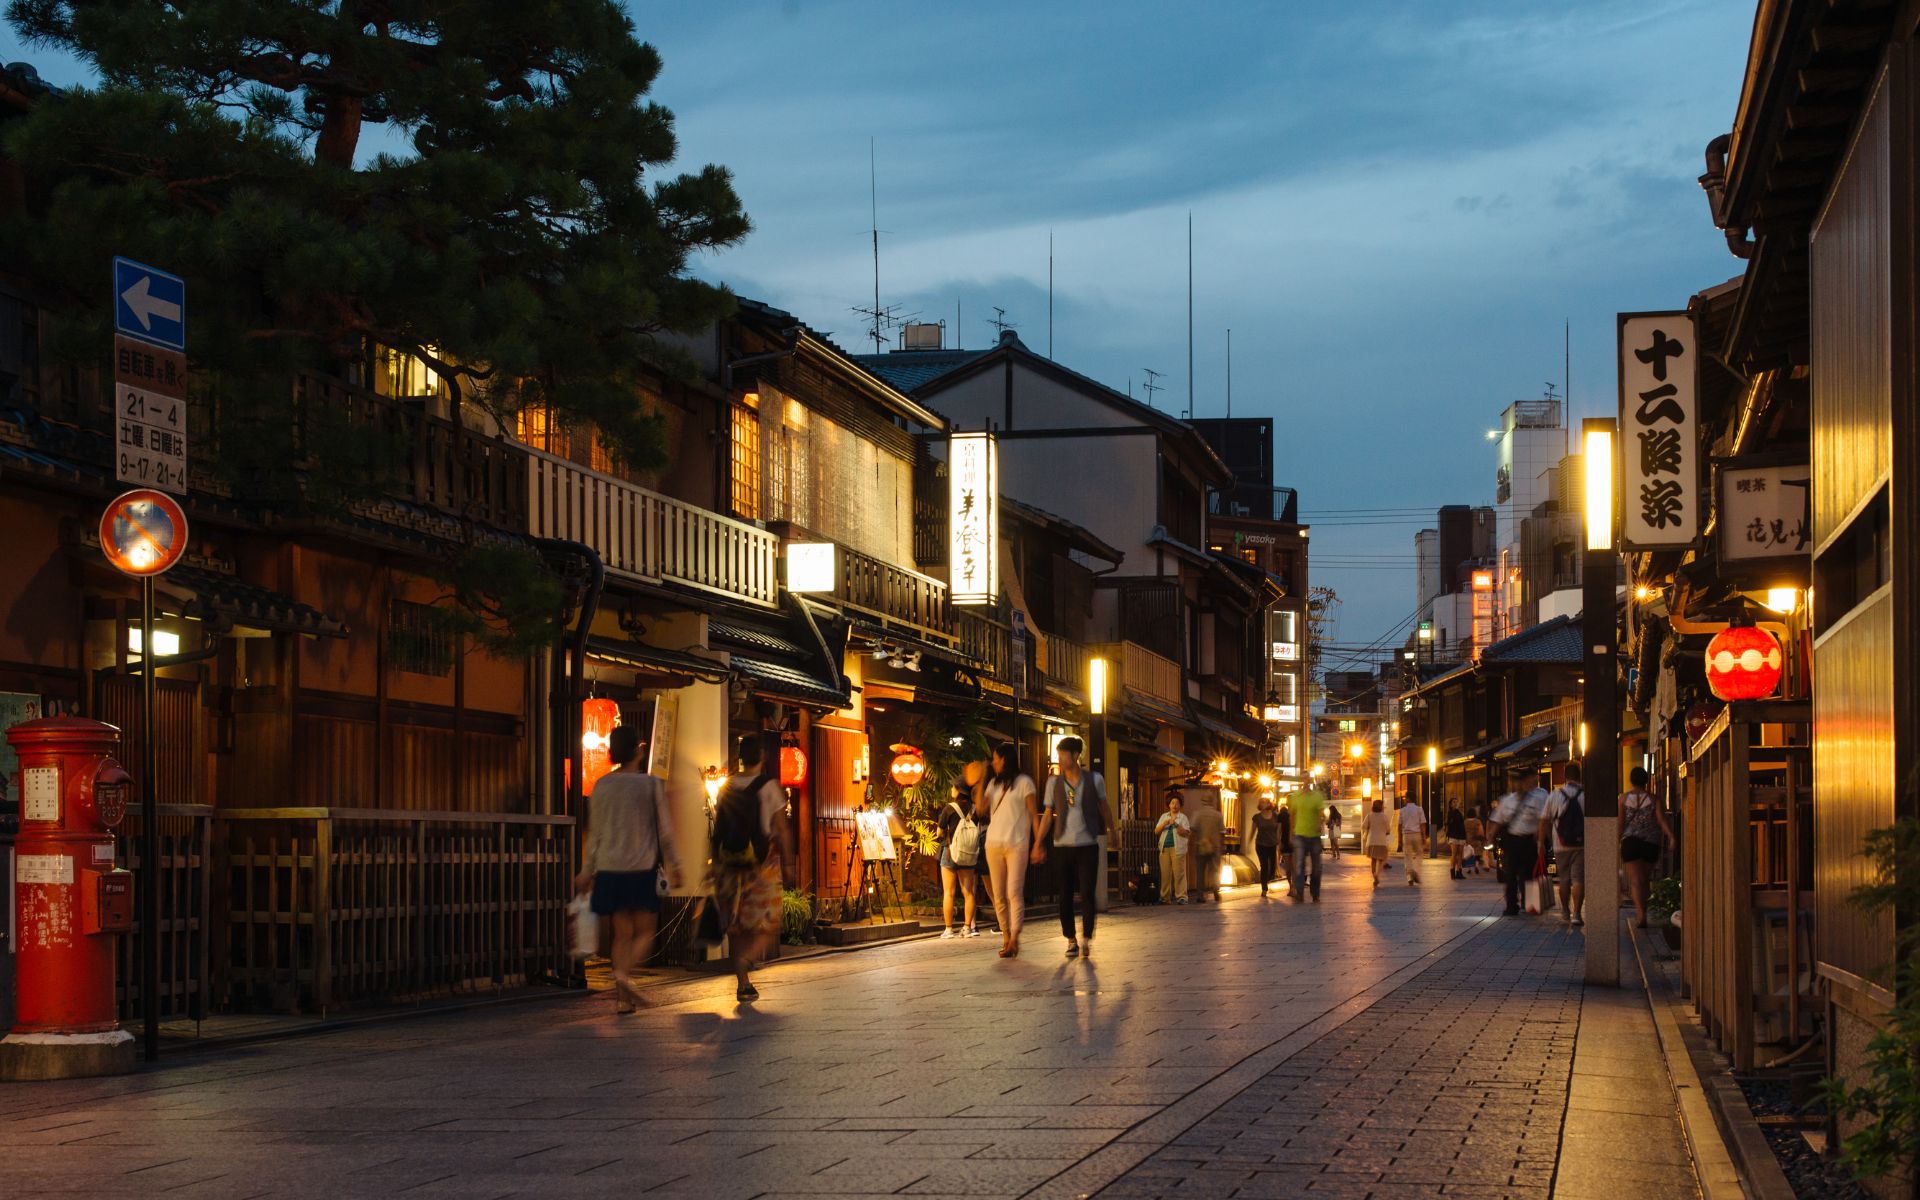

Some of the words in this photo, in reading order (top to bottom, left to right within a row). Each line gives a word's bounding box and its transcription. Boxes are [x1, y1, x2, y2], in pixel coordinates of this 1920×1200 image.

[119, 348, 184, 390] 自転車を除く
[120, 422, 184, 457] 土曜、日曜は
[1634, 329, 1685, 530] 十二段家
[1245, 534, 1276, 545] yasaka
[103, 806, 120, 817] POST
